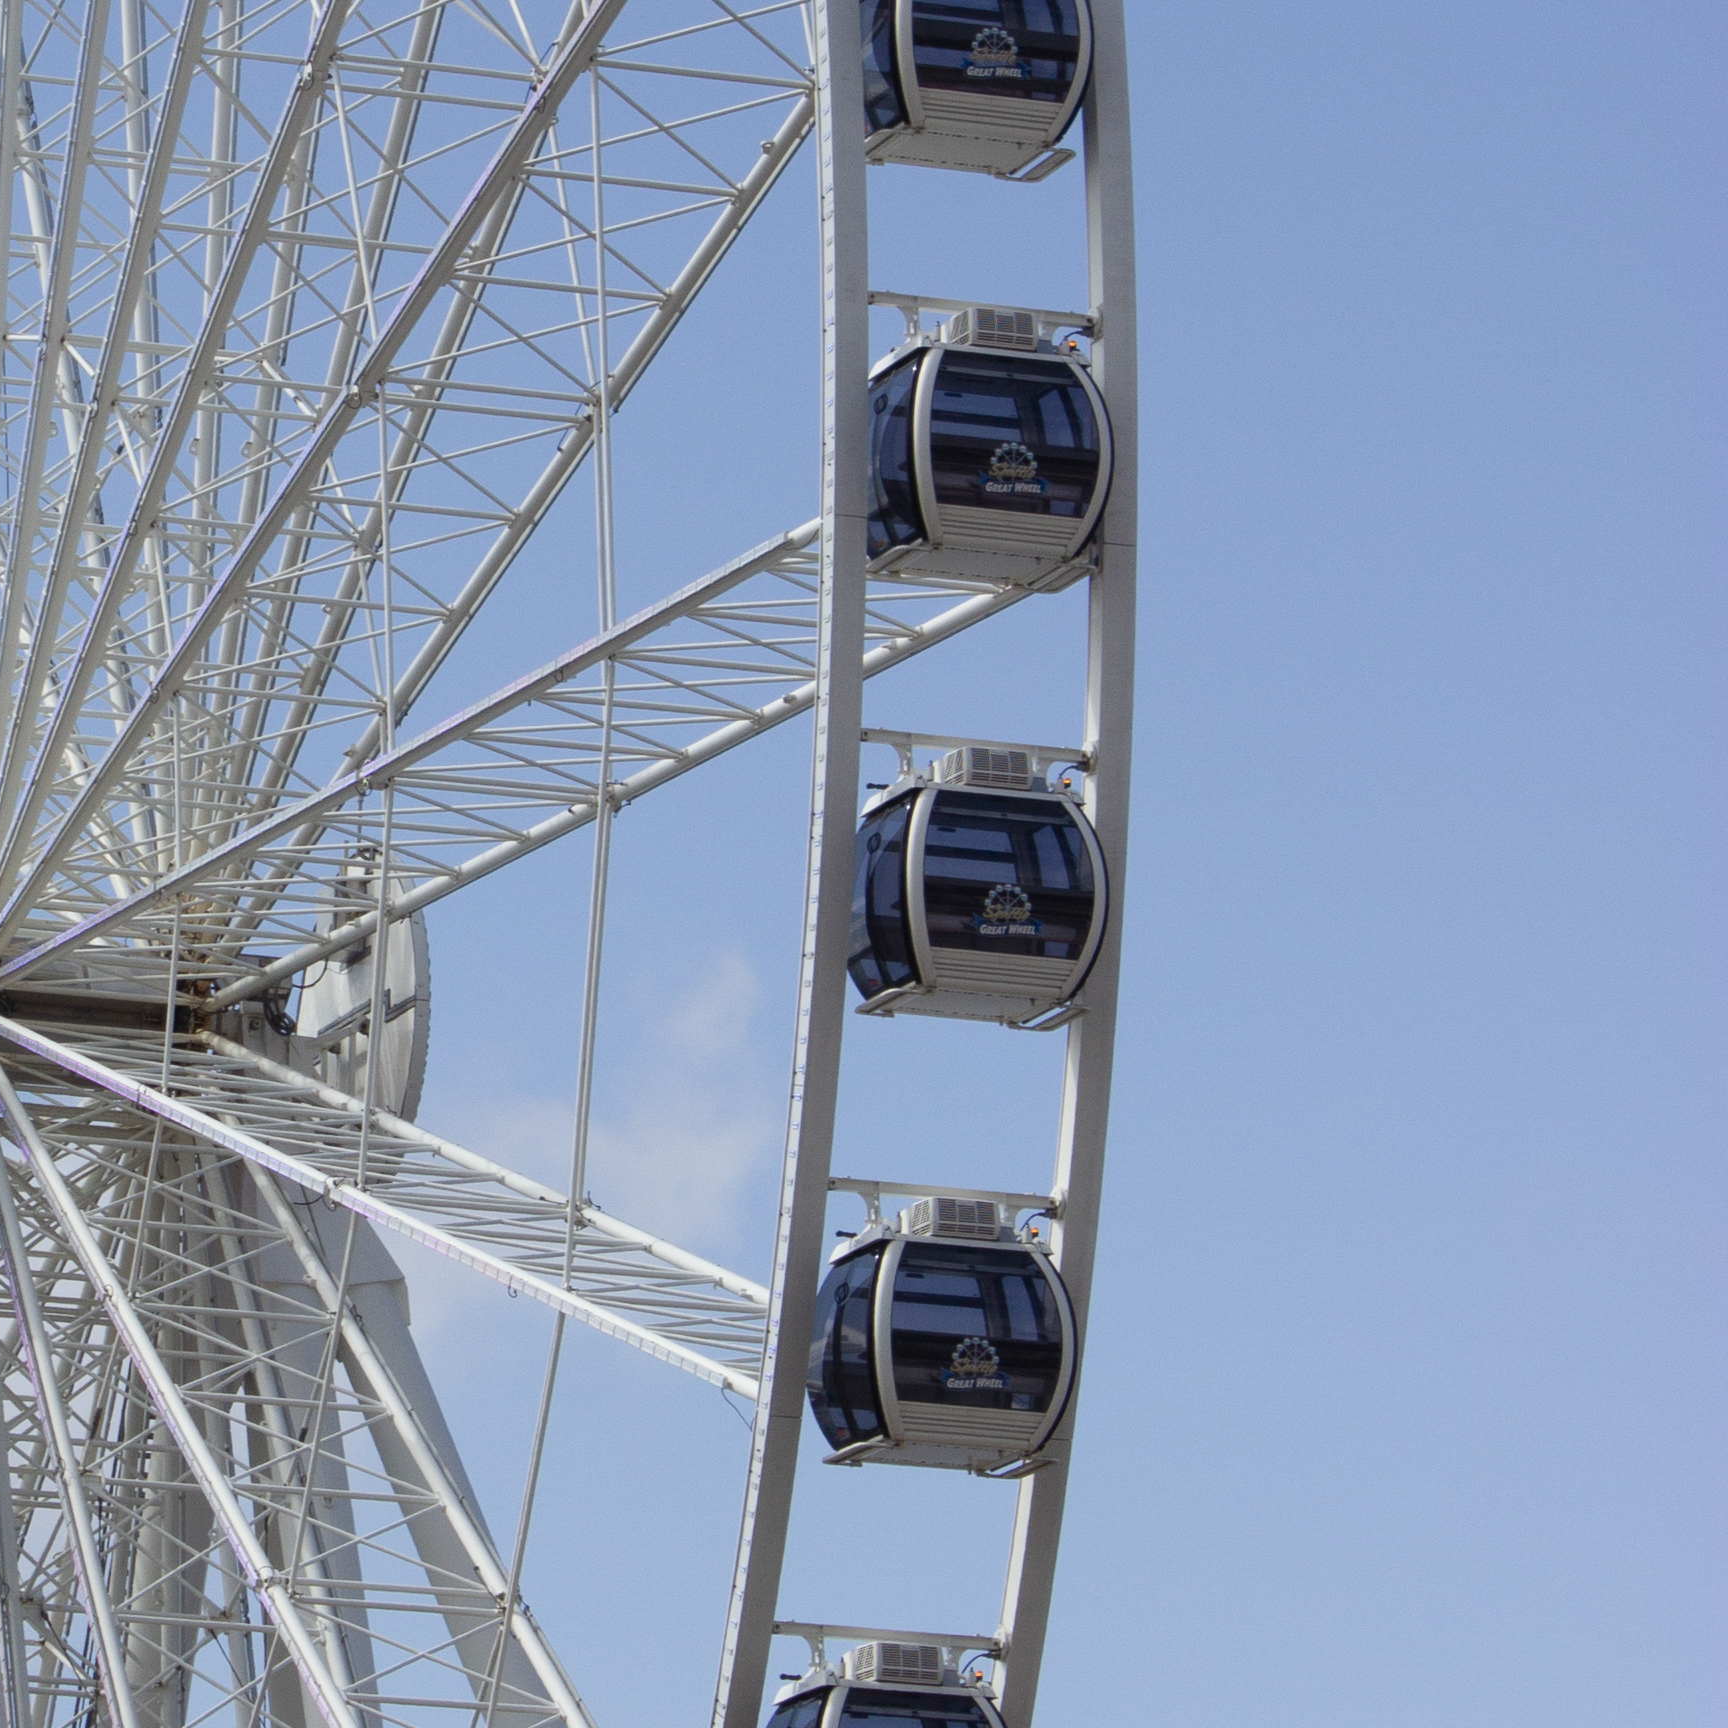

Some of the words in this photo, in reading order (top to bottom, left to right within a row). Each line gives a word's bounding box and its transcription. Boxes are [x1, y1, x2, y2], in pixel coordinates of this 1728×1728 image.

[967, 66, 994, 76] GREAT
[995, 67, 1021, 77] WHEEL
[985, 482, 1013, 492] GREAT
[1014, 482, 1041, 493] WHEEL
[979, 924, 1007, 934] GREAT
[1009, 924, 1035, 934] WHEEL
[947, 1378, 974, 1388] GREAT
[976, 1378, 1003, 1388] WHEEL
